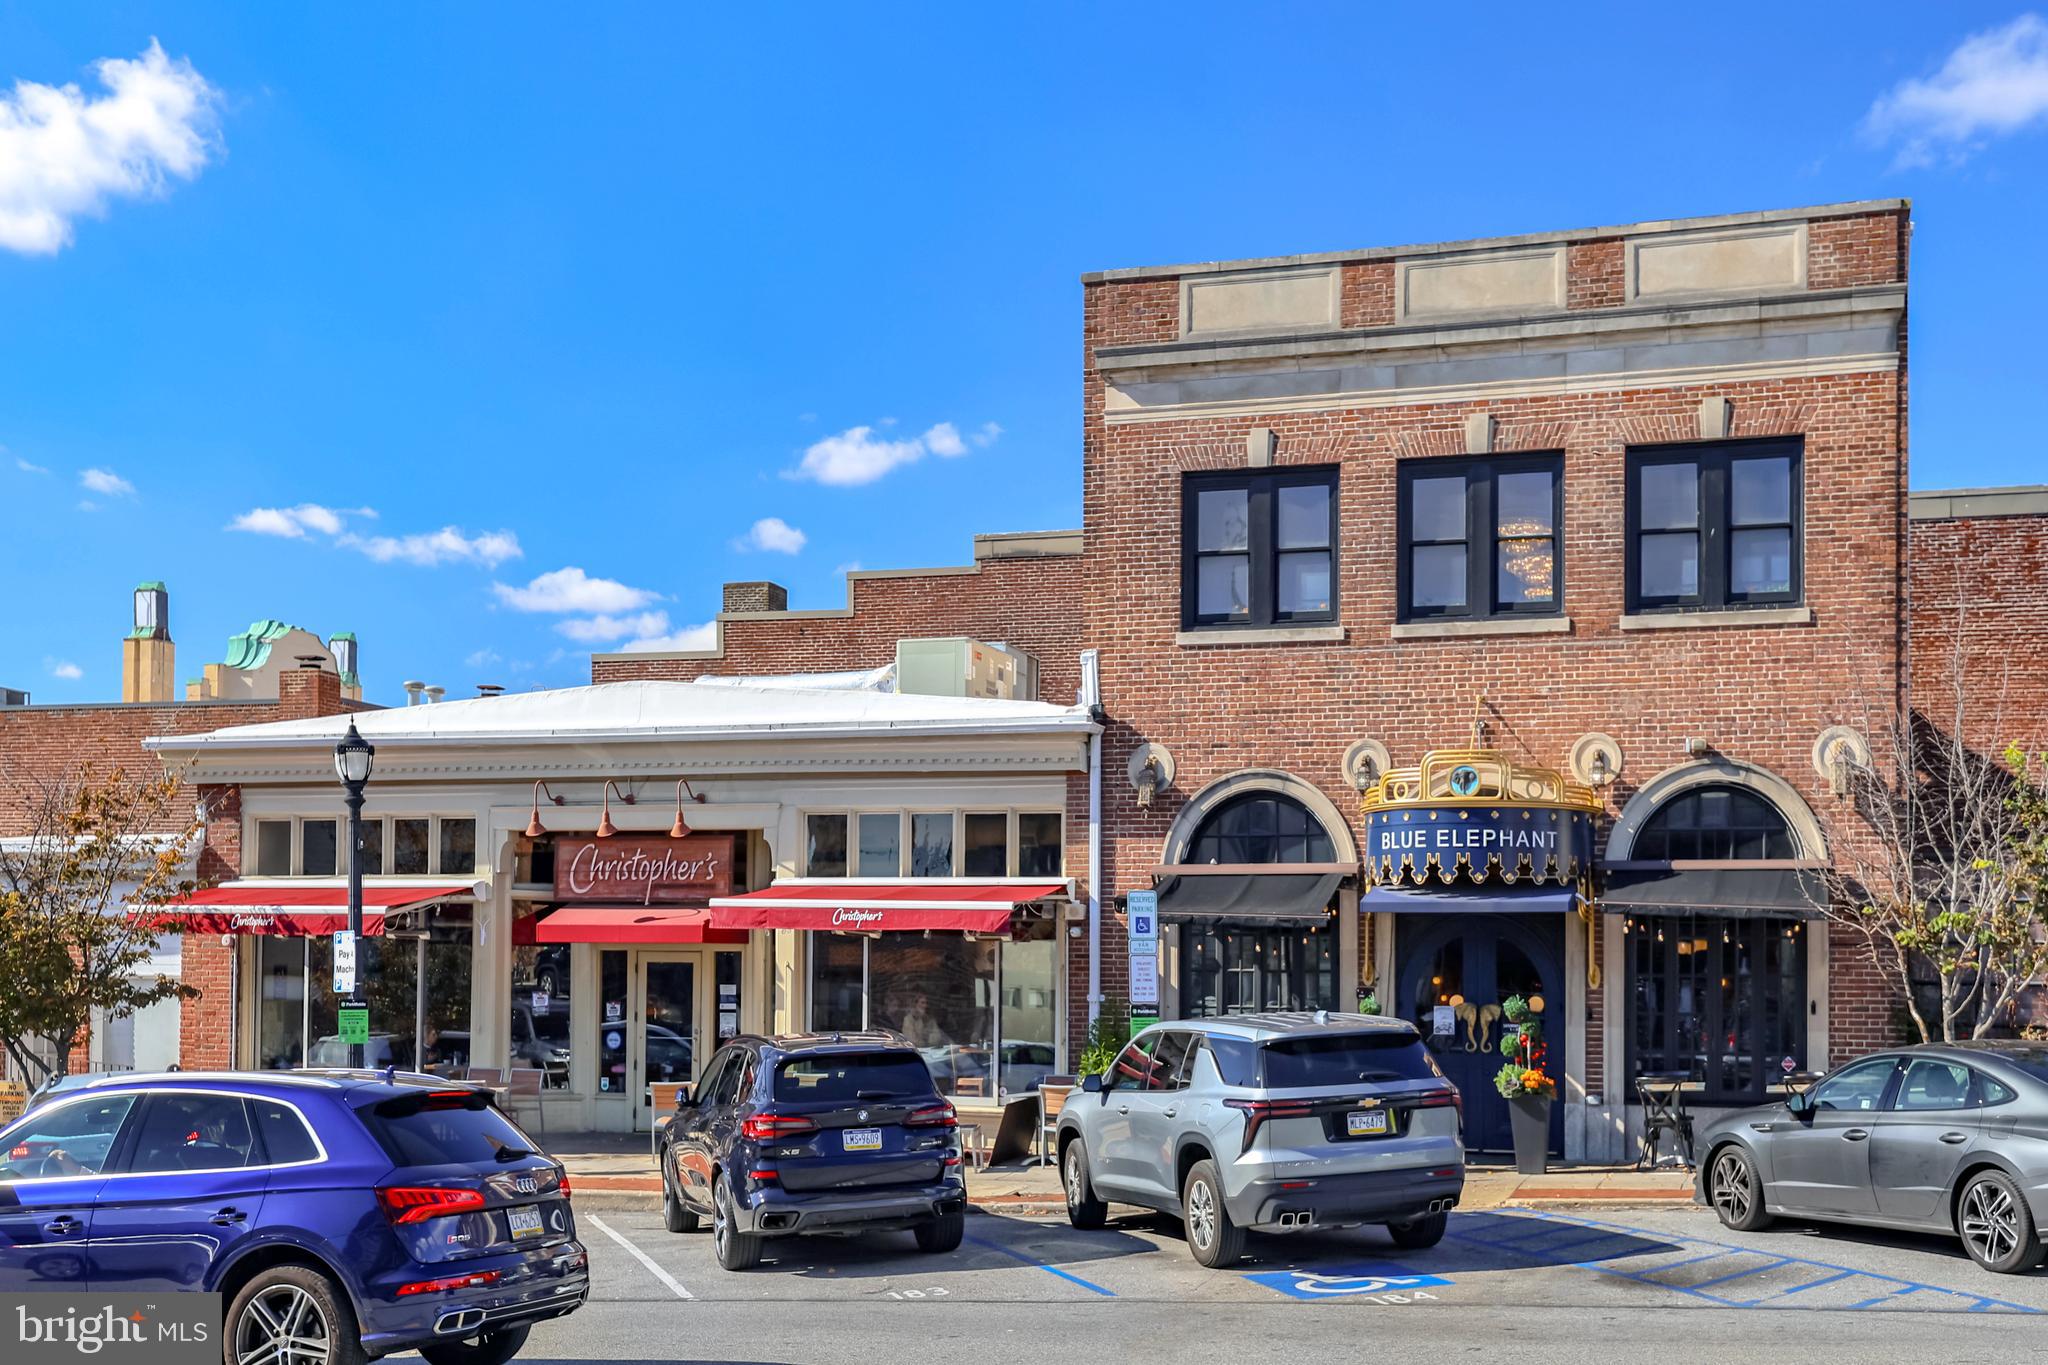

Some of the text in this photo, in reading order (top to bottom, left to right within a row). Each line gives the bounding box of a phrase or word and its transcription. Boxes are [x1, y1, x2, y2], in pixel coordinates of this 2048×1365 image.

[1381, 829, 1557, 849] BLUE ELEPHANT
[569, 843, 718, 906] Christopher's
[338, 949, 350, 960] Pay
[886, 1286, 950, 1299] 183
[1364, 1291, 1440, 1305] 184
